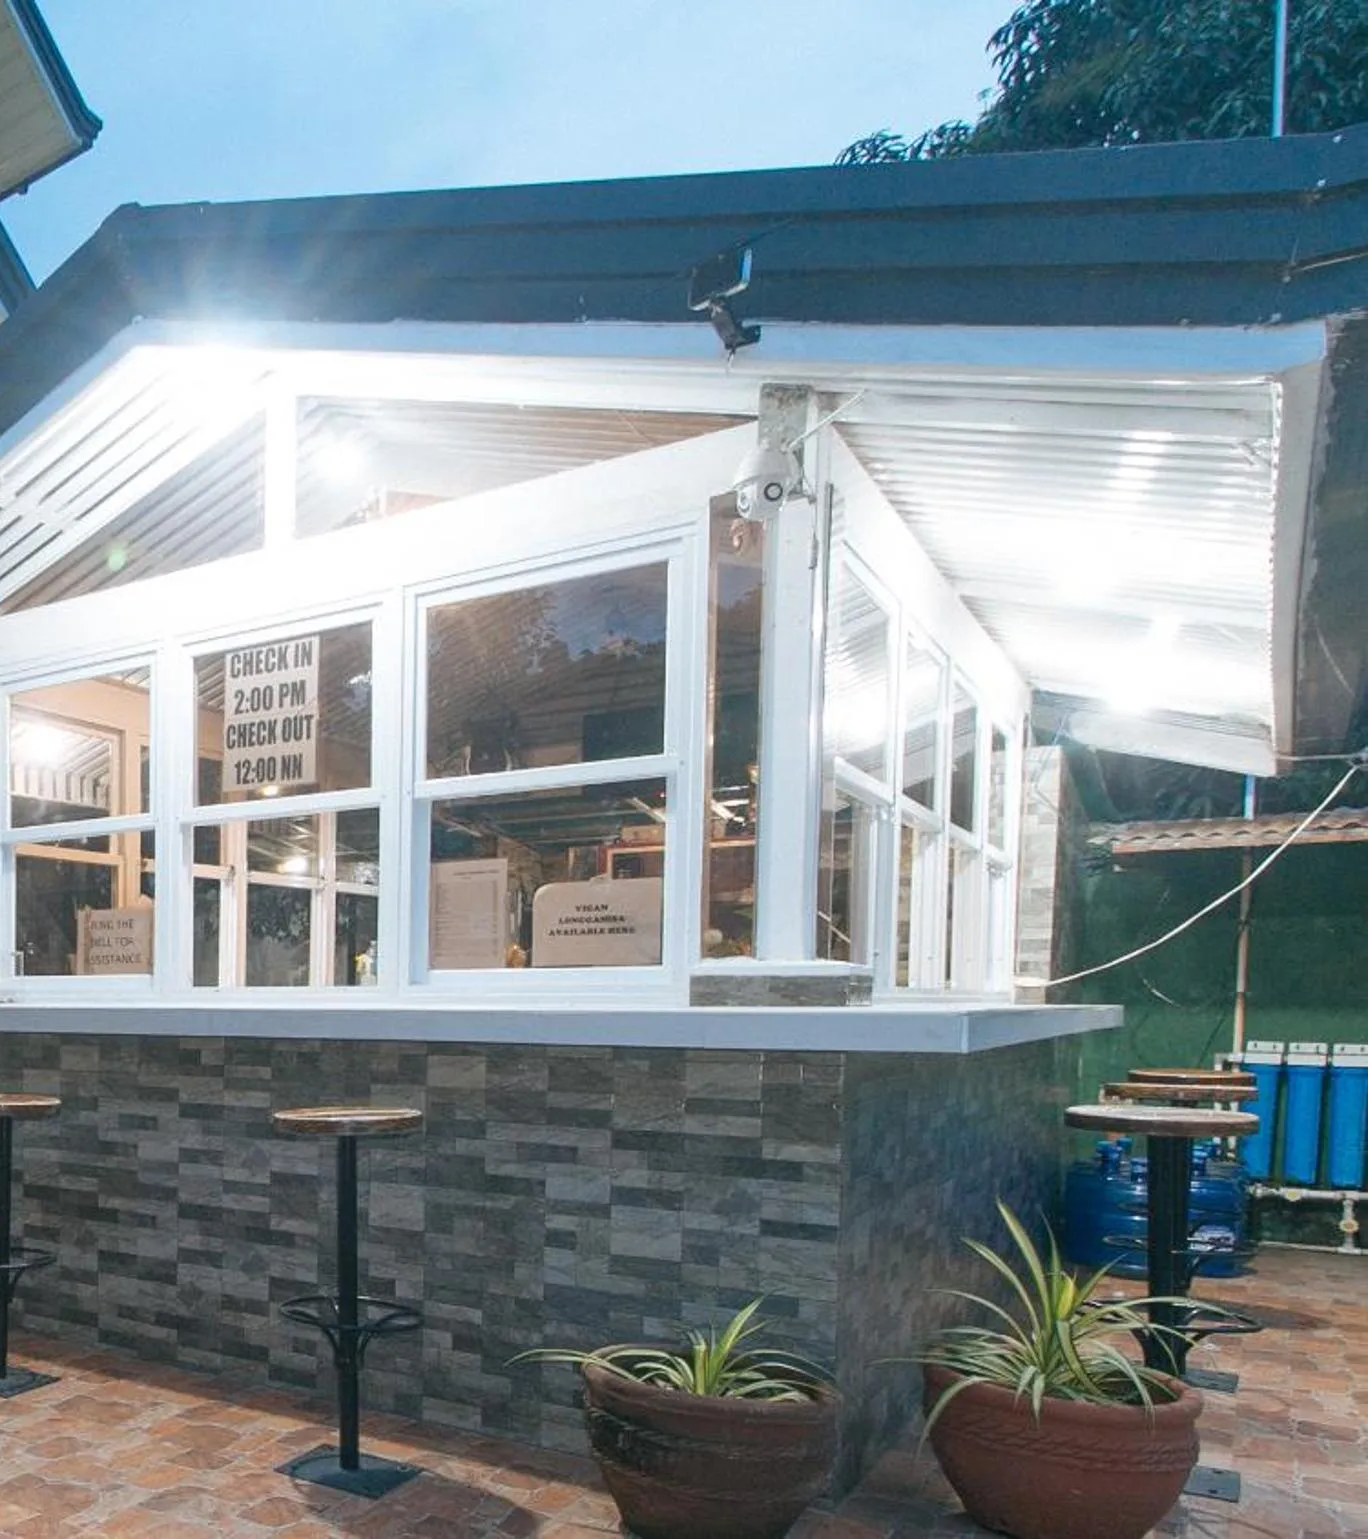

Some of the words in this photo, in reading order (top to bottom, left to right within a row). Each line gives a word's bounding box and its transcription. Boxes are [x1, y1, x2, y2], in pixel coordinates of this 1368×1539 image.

[231, 647, 290, 678] CHECK
[295, 641, 313, 668] IN
[234, 684, 274, 715] 2:00
[279, 680, 306, 708] PM
[226, 719, 277, 750] CHECK
[282, 715, 314, 743] OUT
[234, 756, 277, 784] 12:00
[281, 753, 303, 781] NN
[548, 927, 606, 936] AVAILABLE
[85, 952, 142, 965] SSISTANCE
